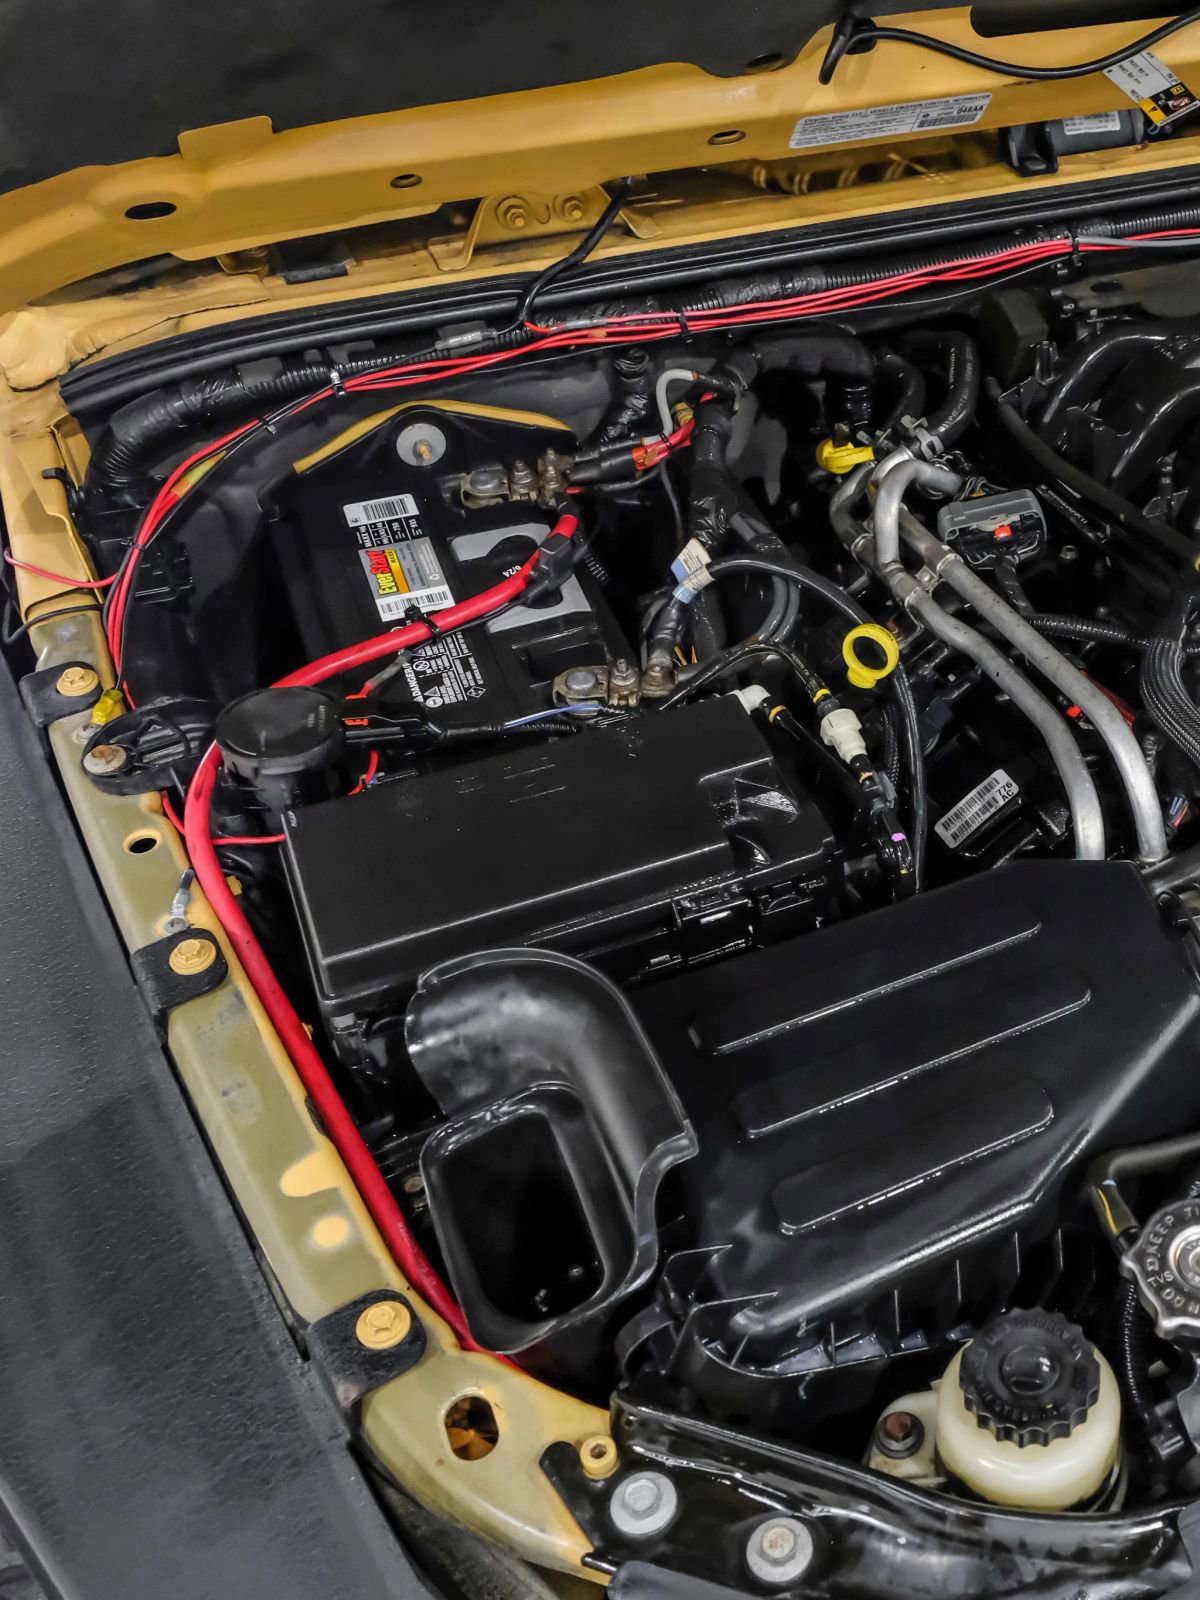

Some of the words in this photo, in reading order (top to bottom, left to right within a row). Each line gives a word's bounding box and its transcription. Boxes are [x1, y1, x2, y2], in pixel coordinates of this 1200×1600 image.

[387, 551, 396, 564] MAXX
[366, 550, 398, 595] EverStart
[995, 781, 1013, 796] 776
[1002, 789, 1014, 802] AC
[1146, 1215, 1174, 1258] KEEP
[1162, 1287, 1185, 1308] DO
